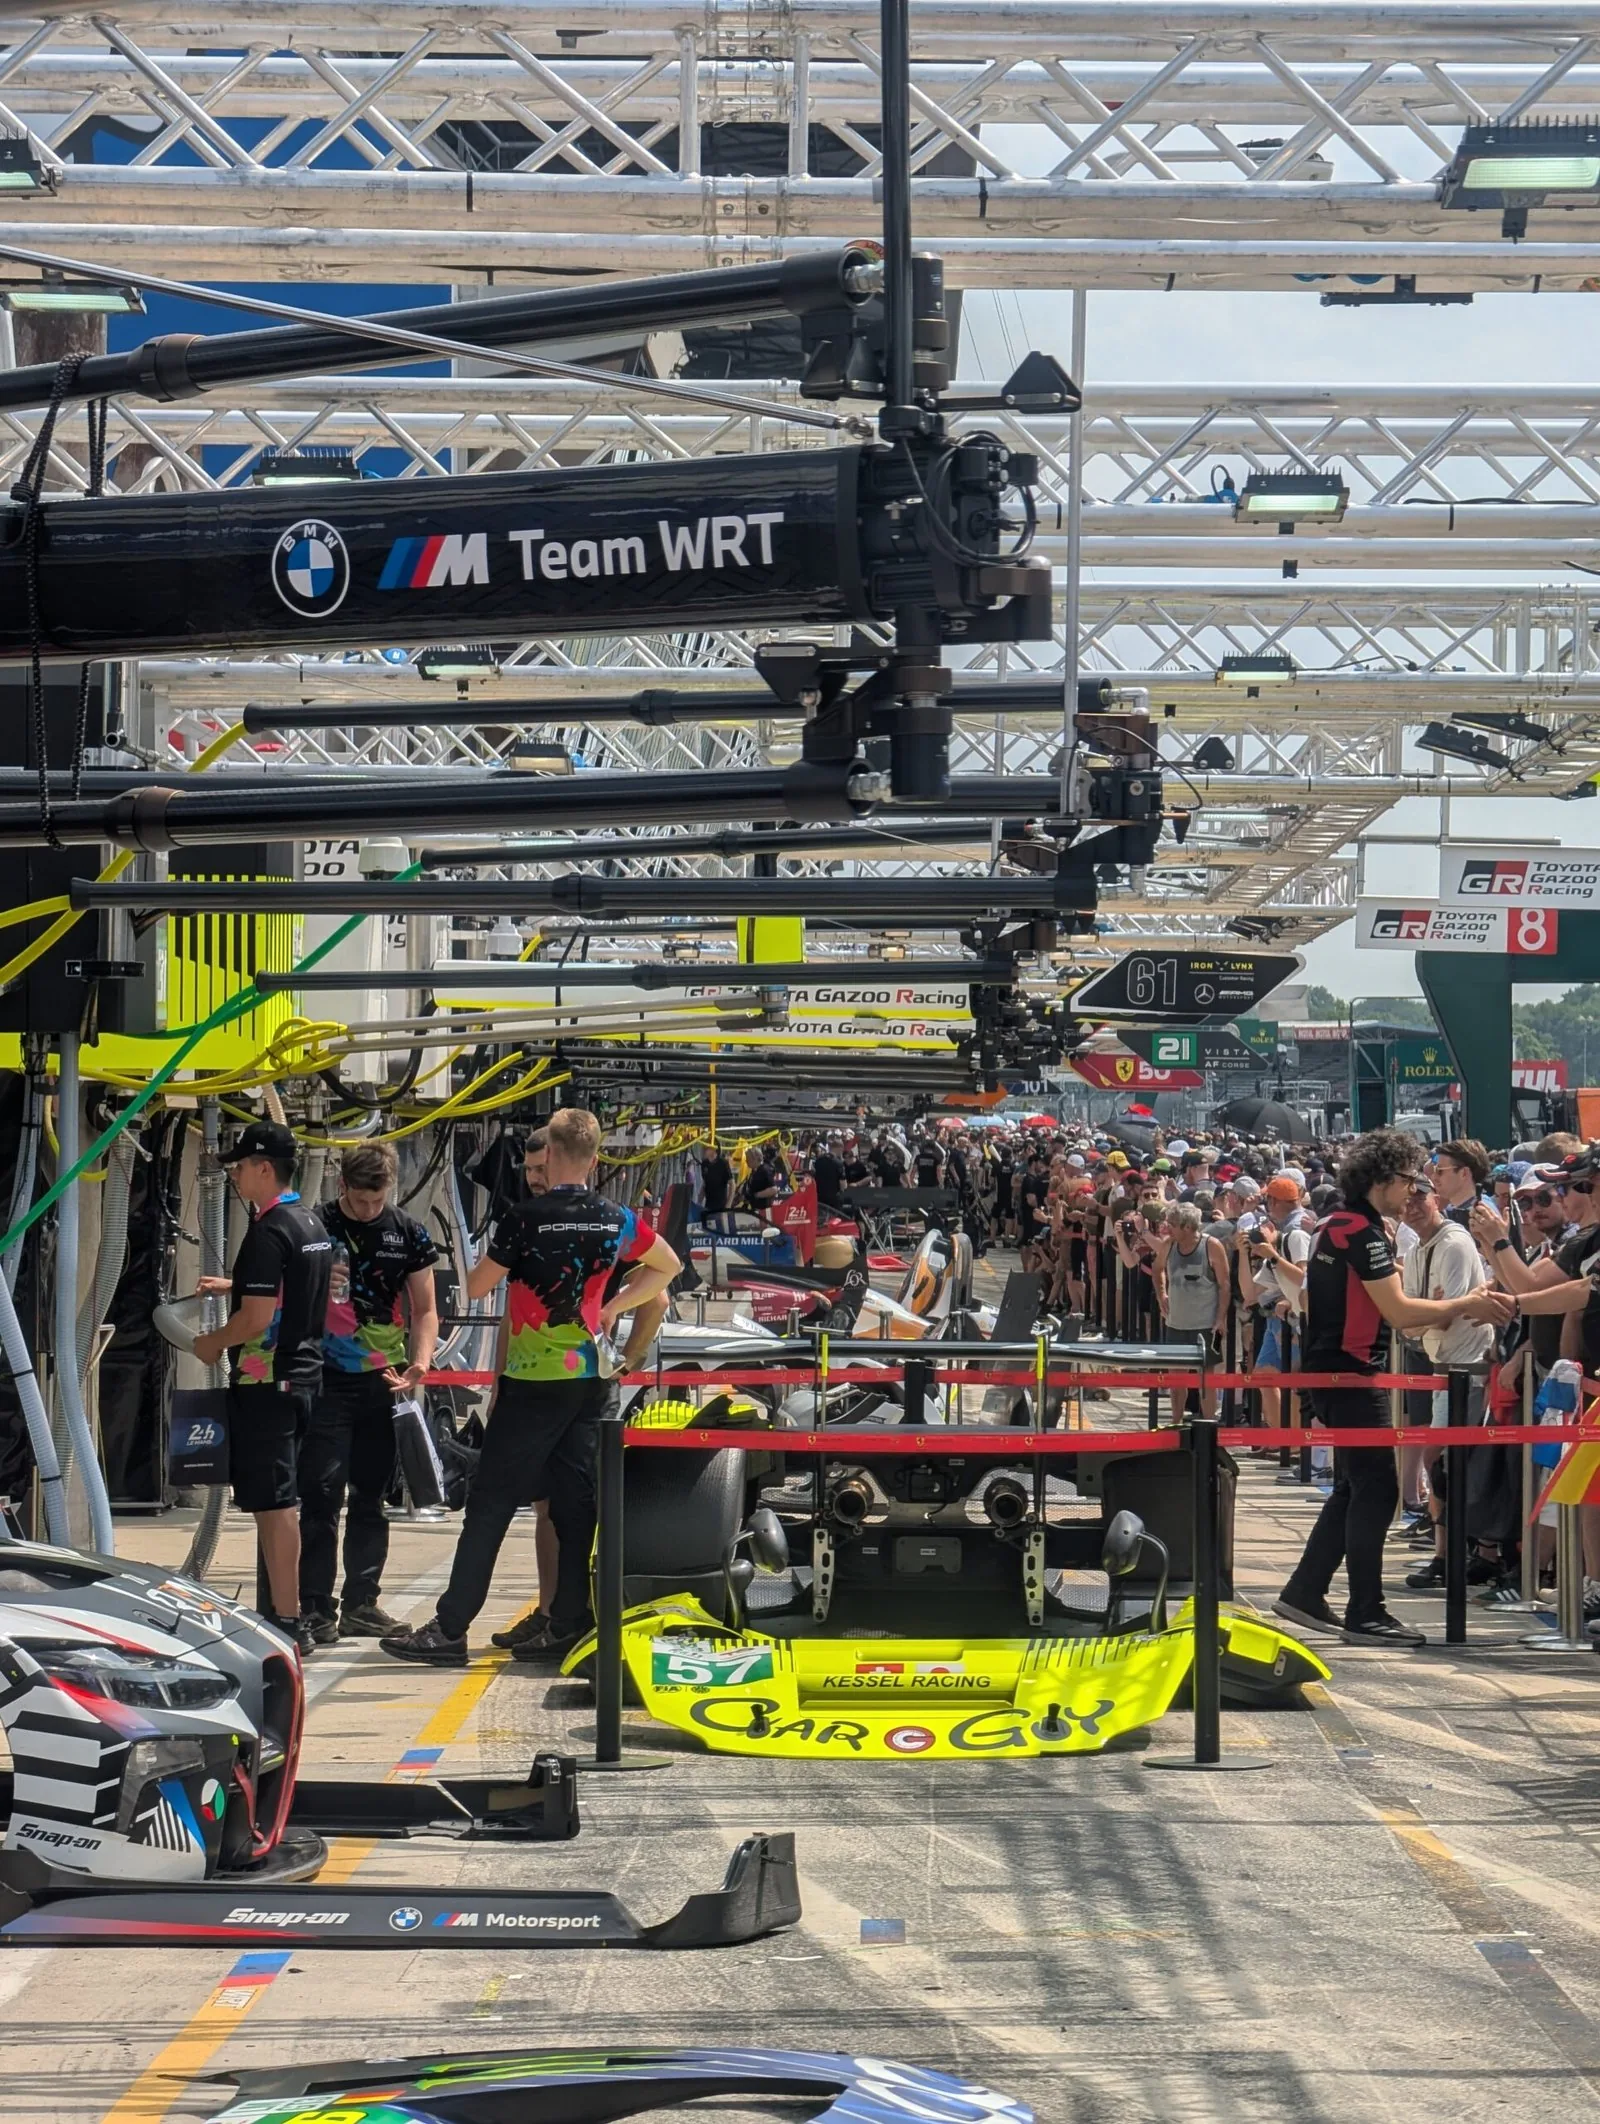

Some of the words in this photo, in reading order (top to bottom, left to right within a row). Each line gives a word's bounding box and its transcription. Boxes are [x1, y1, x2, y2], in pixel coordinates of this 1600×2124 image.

[508, 529, 647, 580] Team
[658, 511, 785, 571] WRT
[1530, 873, 1597, 884] GAZOO
[1528, 885, 1594, 898] Racing
[1435, 911, 1498, 921] TOYOTA
[1432, 921, 1491, 931] GAZOO
[1517, 908, 1547, 951] 8
[1430, 931, 1487, 943] Racing
[1190, 961, 1213, 970] IRON
[1230, 962, 1254, 970] LYNX
[1127, 957, 1178, 1006] 61
[815, 988, 891, 1003] GAZOO
[896, 989, 967, 1009] Racing
[1158, 1036, 1190, 1061] 21
[1204, 1048, 1250, 1056] VISTA
[1204, 1061, 1219, 1069] AF
[1404, 1065, 1456, 1077] ROLEX
[538, 1223, 619, 1234] PORSCHE
[667, 1654, 762, 1685] 57
[822, 1675, 905, 1689] KESSEL
[911, 1675, 991, 1689] RACING
[15, 1822, 102, 1850] Snap-on
[221, 1907, 351, 1927] Snap-on
[486, 1912, 602, 1931] Motorsport
